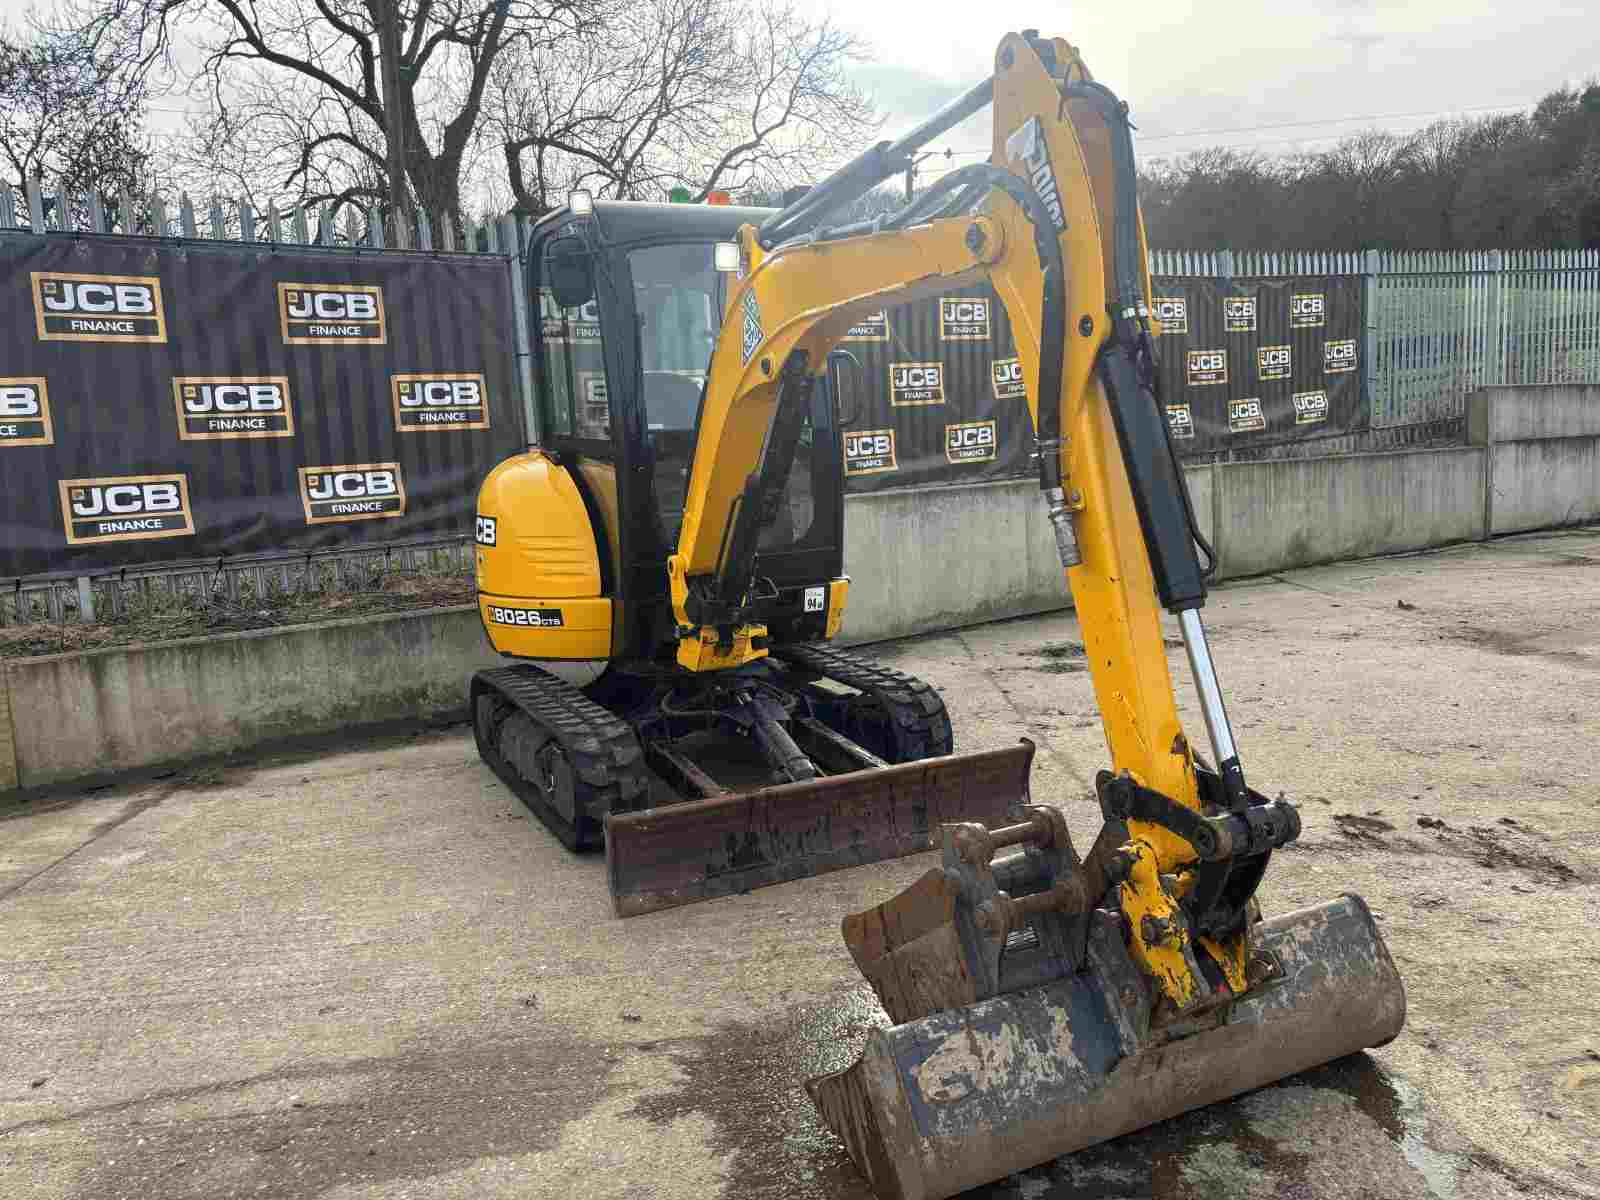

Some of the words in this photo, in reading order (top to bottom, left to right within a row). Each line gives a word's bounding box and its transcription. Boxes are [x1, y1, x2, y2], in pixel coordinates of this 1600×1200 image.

[46, 282, 153, 312] JCB
[289, 292, 377, 318] JCB
[943, 303, 985, 322] JCB
[1227, 302, 1253, 317] JCB
[1293, 299, 1322, 313] JCB
[71, 321, 134, 332] FINANCE
[309, 326, 361, 336] FINANCE
[1262, 351, 1288, 365] JCB
[1327, 345, 1353, 360] JCB
[1190, 356, 1223, 370] JCB
[895, 368, 938, 388] JCB
[996, 364, 1020, 382] JC
[186, 385, 282, 412] JCB
[401, 381, 480, 406] JCB
[1297, 396, 1325, 410] JCB
[419, 412, 466, 422] FINANCE
[1231, 404, 1259, 418] JCB
[208, 419, 266, 430] FINANCE
[950, 427, 993, 446] JCB
[847, 436, 890, 456] JCB
[308, 471, 396, 499] JCB
[73, 484, 180, 516] JCB
[331, 501, 382, 513] FINANCE
[99, 519, 162, 533] FINANCE
[475, 516, 493, 541] CB
